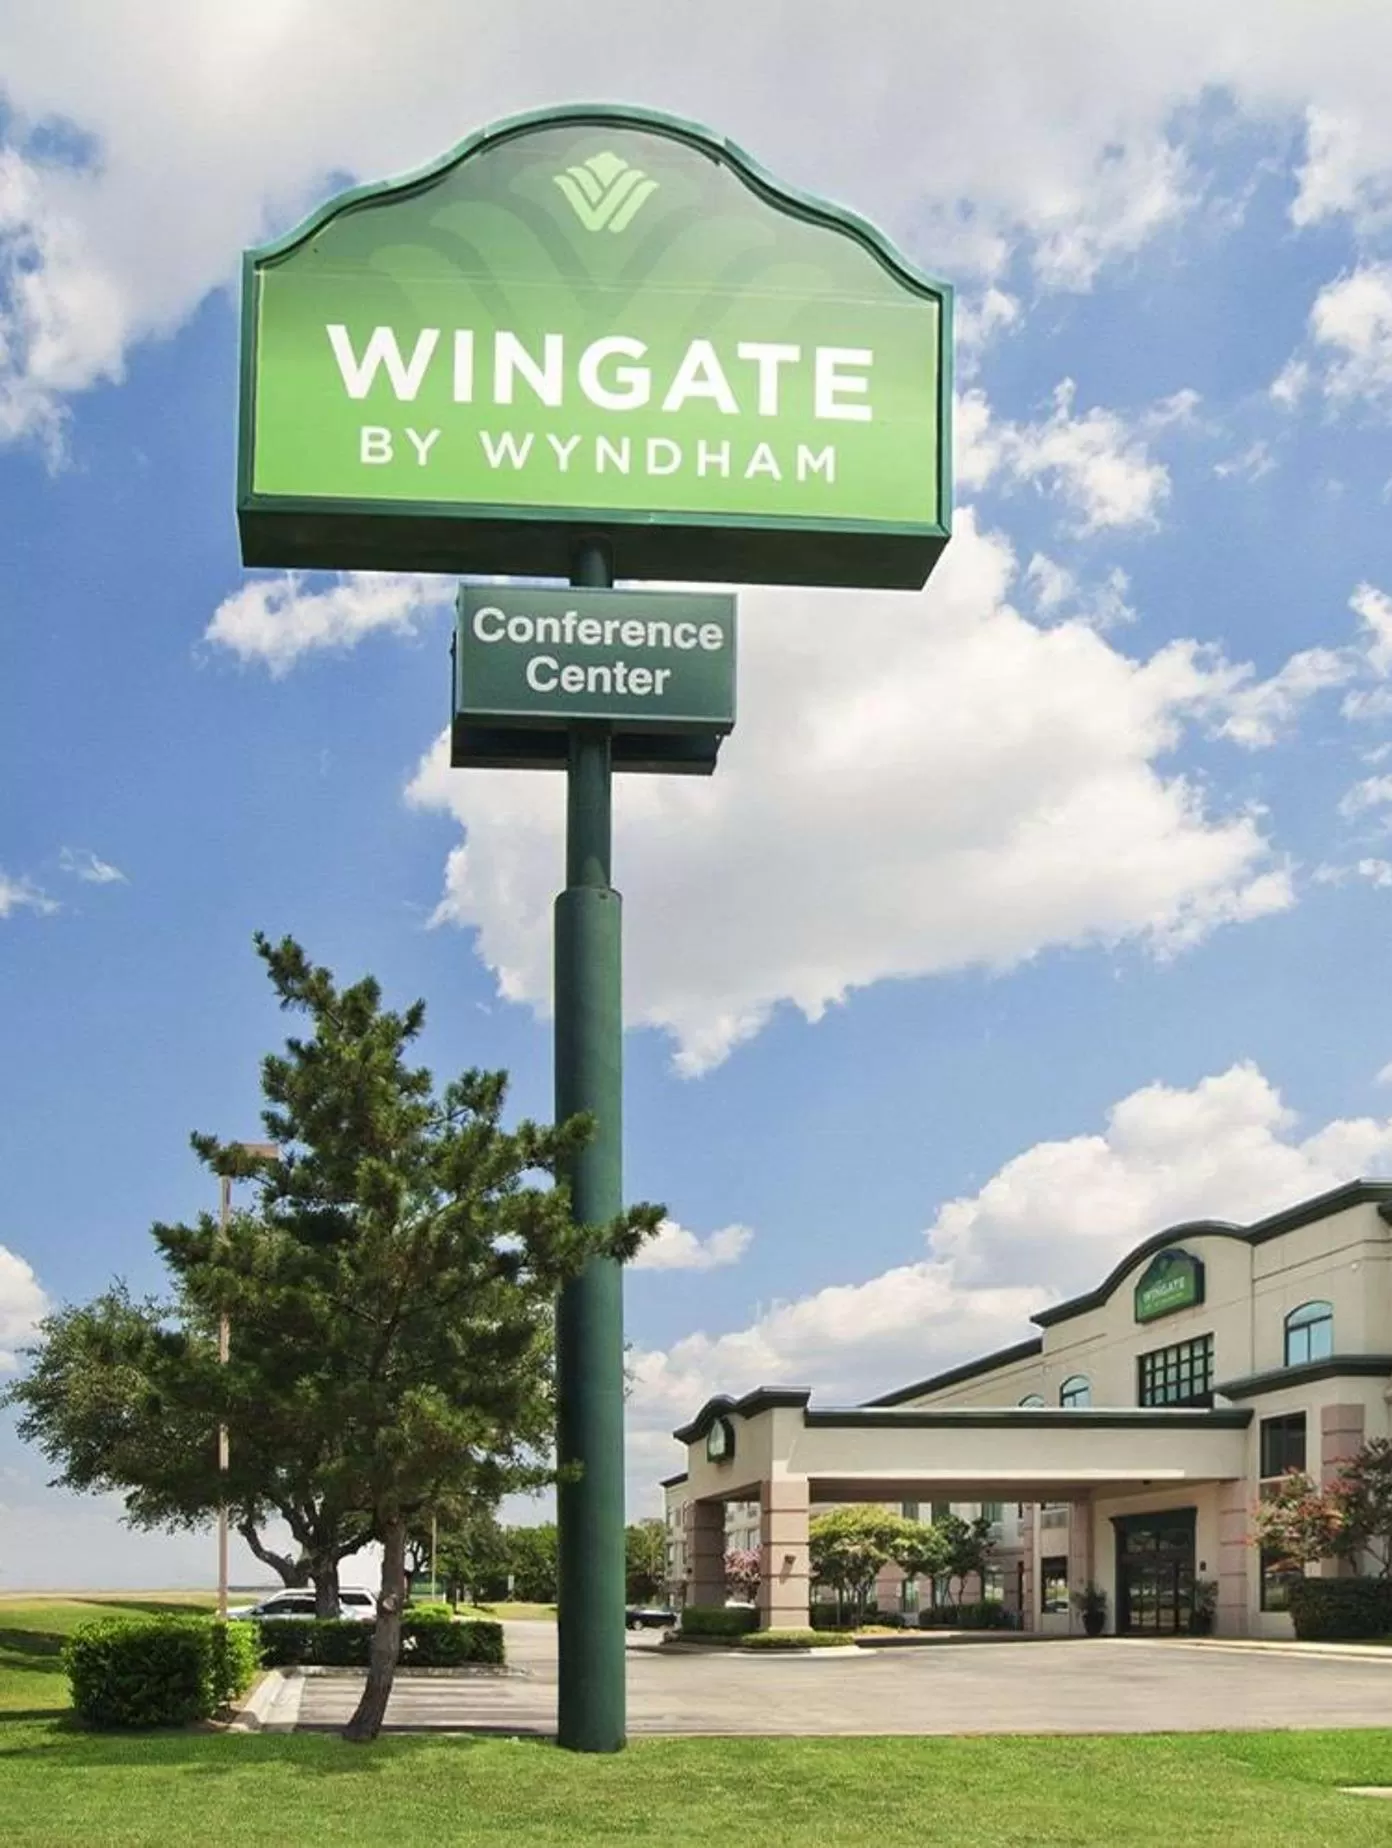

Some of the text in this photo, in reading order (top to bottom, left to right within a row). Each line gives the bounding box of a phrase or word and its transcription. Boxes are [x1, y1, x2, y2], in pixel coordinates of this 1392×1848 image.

[326, 323, 874, 421] WINGATE
[360, 427, 836, 483] BY WYNDHAM
[473, 606, 724, 651] Conference
[525, 655, 671, 695] Center
